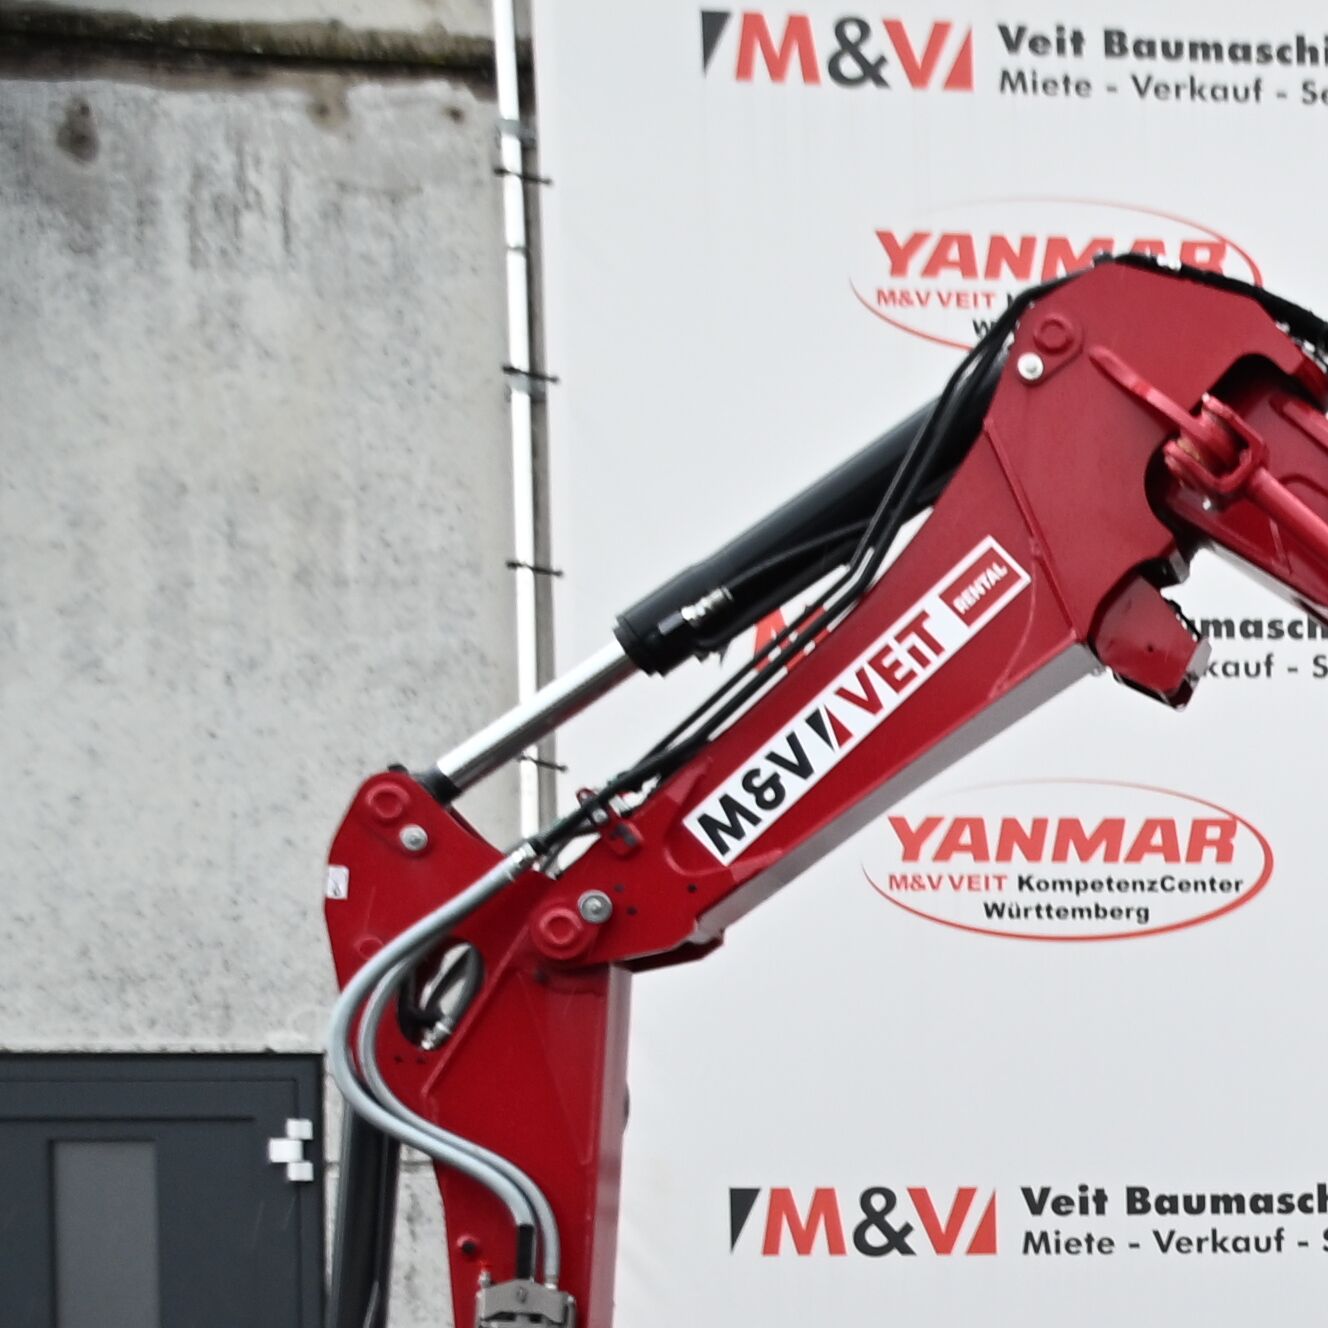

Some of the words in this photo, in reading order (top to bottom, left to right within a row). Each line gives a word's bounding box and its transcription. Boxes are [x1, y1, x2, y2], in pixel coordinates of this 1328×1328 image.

[734, 12, 951, 89] M&V
[998, 24, 1084, 57] Veit
[1000, 69, 1091, 96] Miete
[1131, 74, 1262, 103] Verkauf
[877, 289, 932, 308] M&V
[937, 291, 996, 309] VEIT
[952, 562, 1008, 614] RENTAL
[697, 731, 815, 856] M&V
[888, 816, 1237, 864] YANMAR
[889, 874, 945, 891] M&V
[949, 874, 1008, 891] VEIT
[1017, 875, 1244, 898] KompetenzCenter
[983, 901, 1150, 925] Württemberg
[1021, 1184, 1108, 1216] Veit
[762, 1187, 976, 1256] M&V
[1023, 1230, 1114, 1255] Miete
[1153, 1227, 1284, 1254] Verkauf
